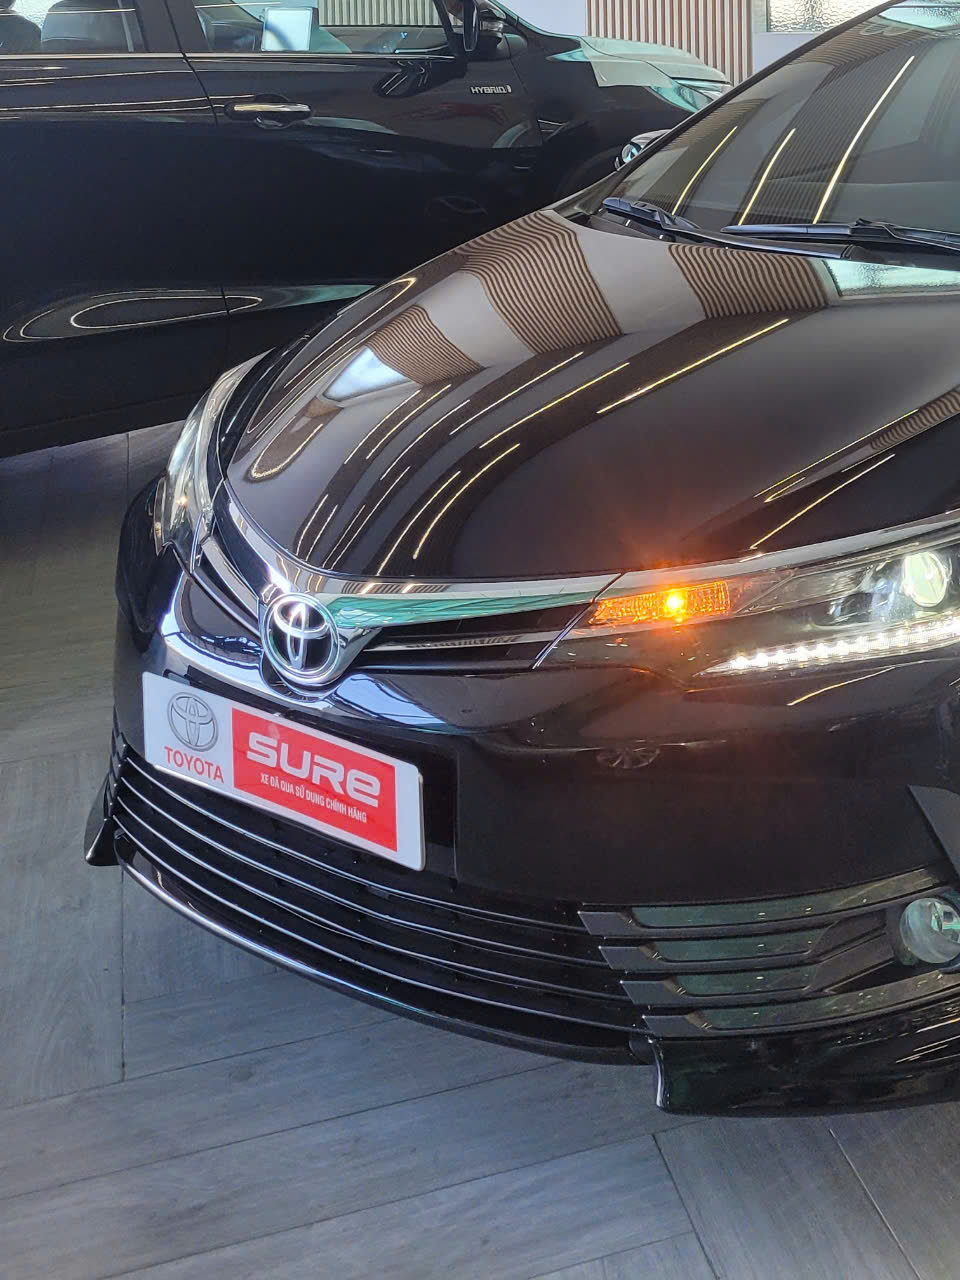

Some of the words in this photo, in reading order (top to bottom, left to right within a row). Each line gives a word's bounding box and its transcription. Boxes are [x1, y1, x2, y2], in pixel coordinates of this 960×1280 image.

[470, 86, 507, 94] HYBRID
[164, 746, 224, 784] TOYOTA
[260, 772, 269, 785] XE
[280, 780, 295, 795] QUA
